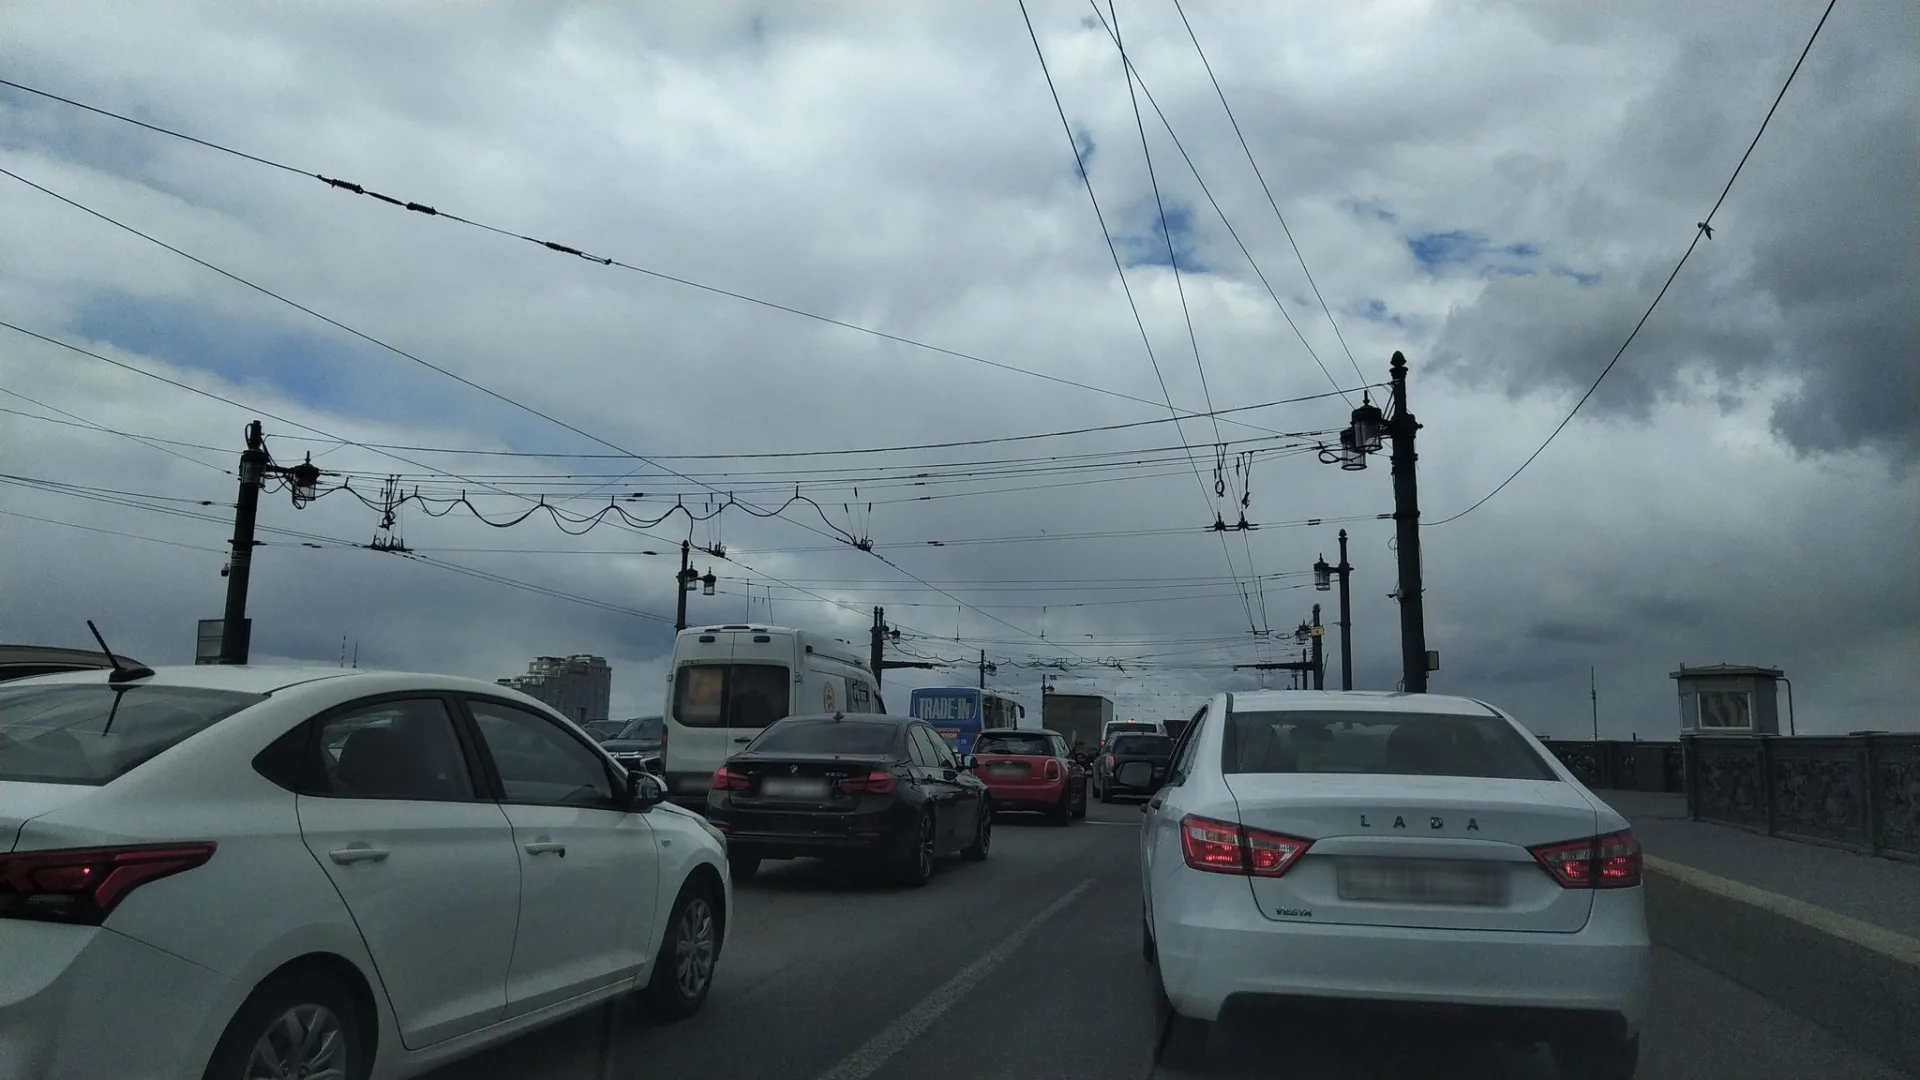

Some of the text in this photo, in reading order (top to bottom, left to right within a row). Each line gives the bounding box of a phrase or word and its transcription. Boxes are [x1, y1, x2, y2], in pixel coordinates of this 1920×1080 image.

[919, 697, 971, 720] TRADE-IN
[1360, 814, 1480, 831] LADA
[1275, 905, 1313, 917] VESTA
